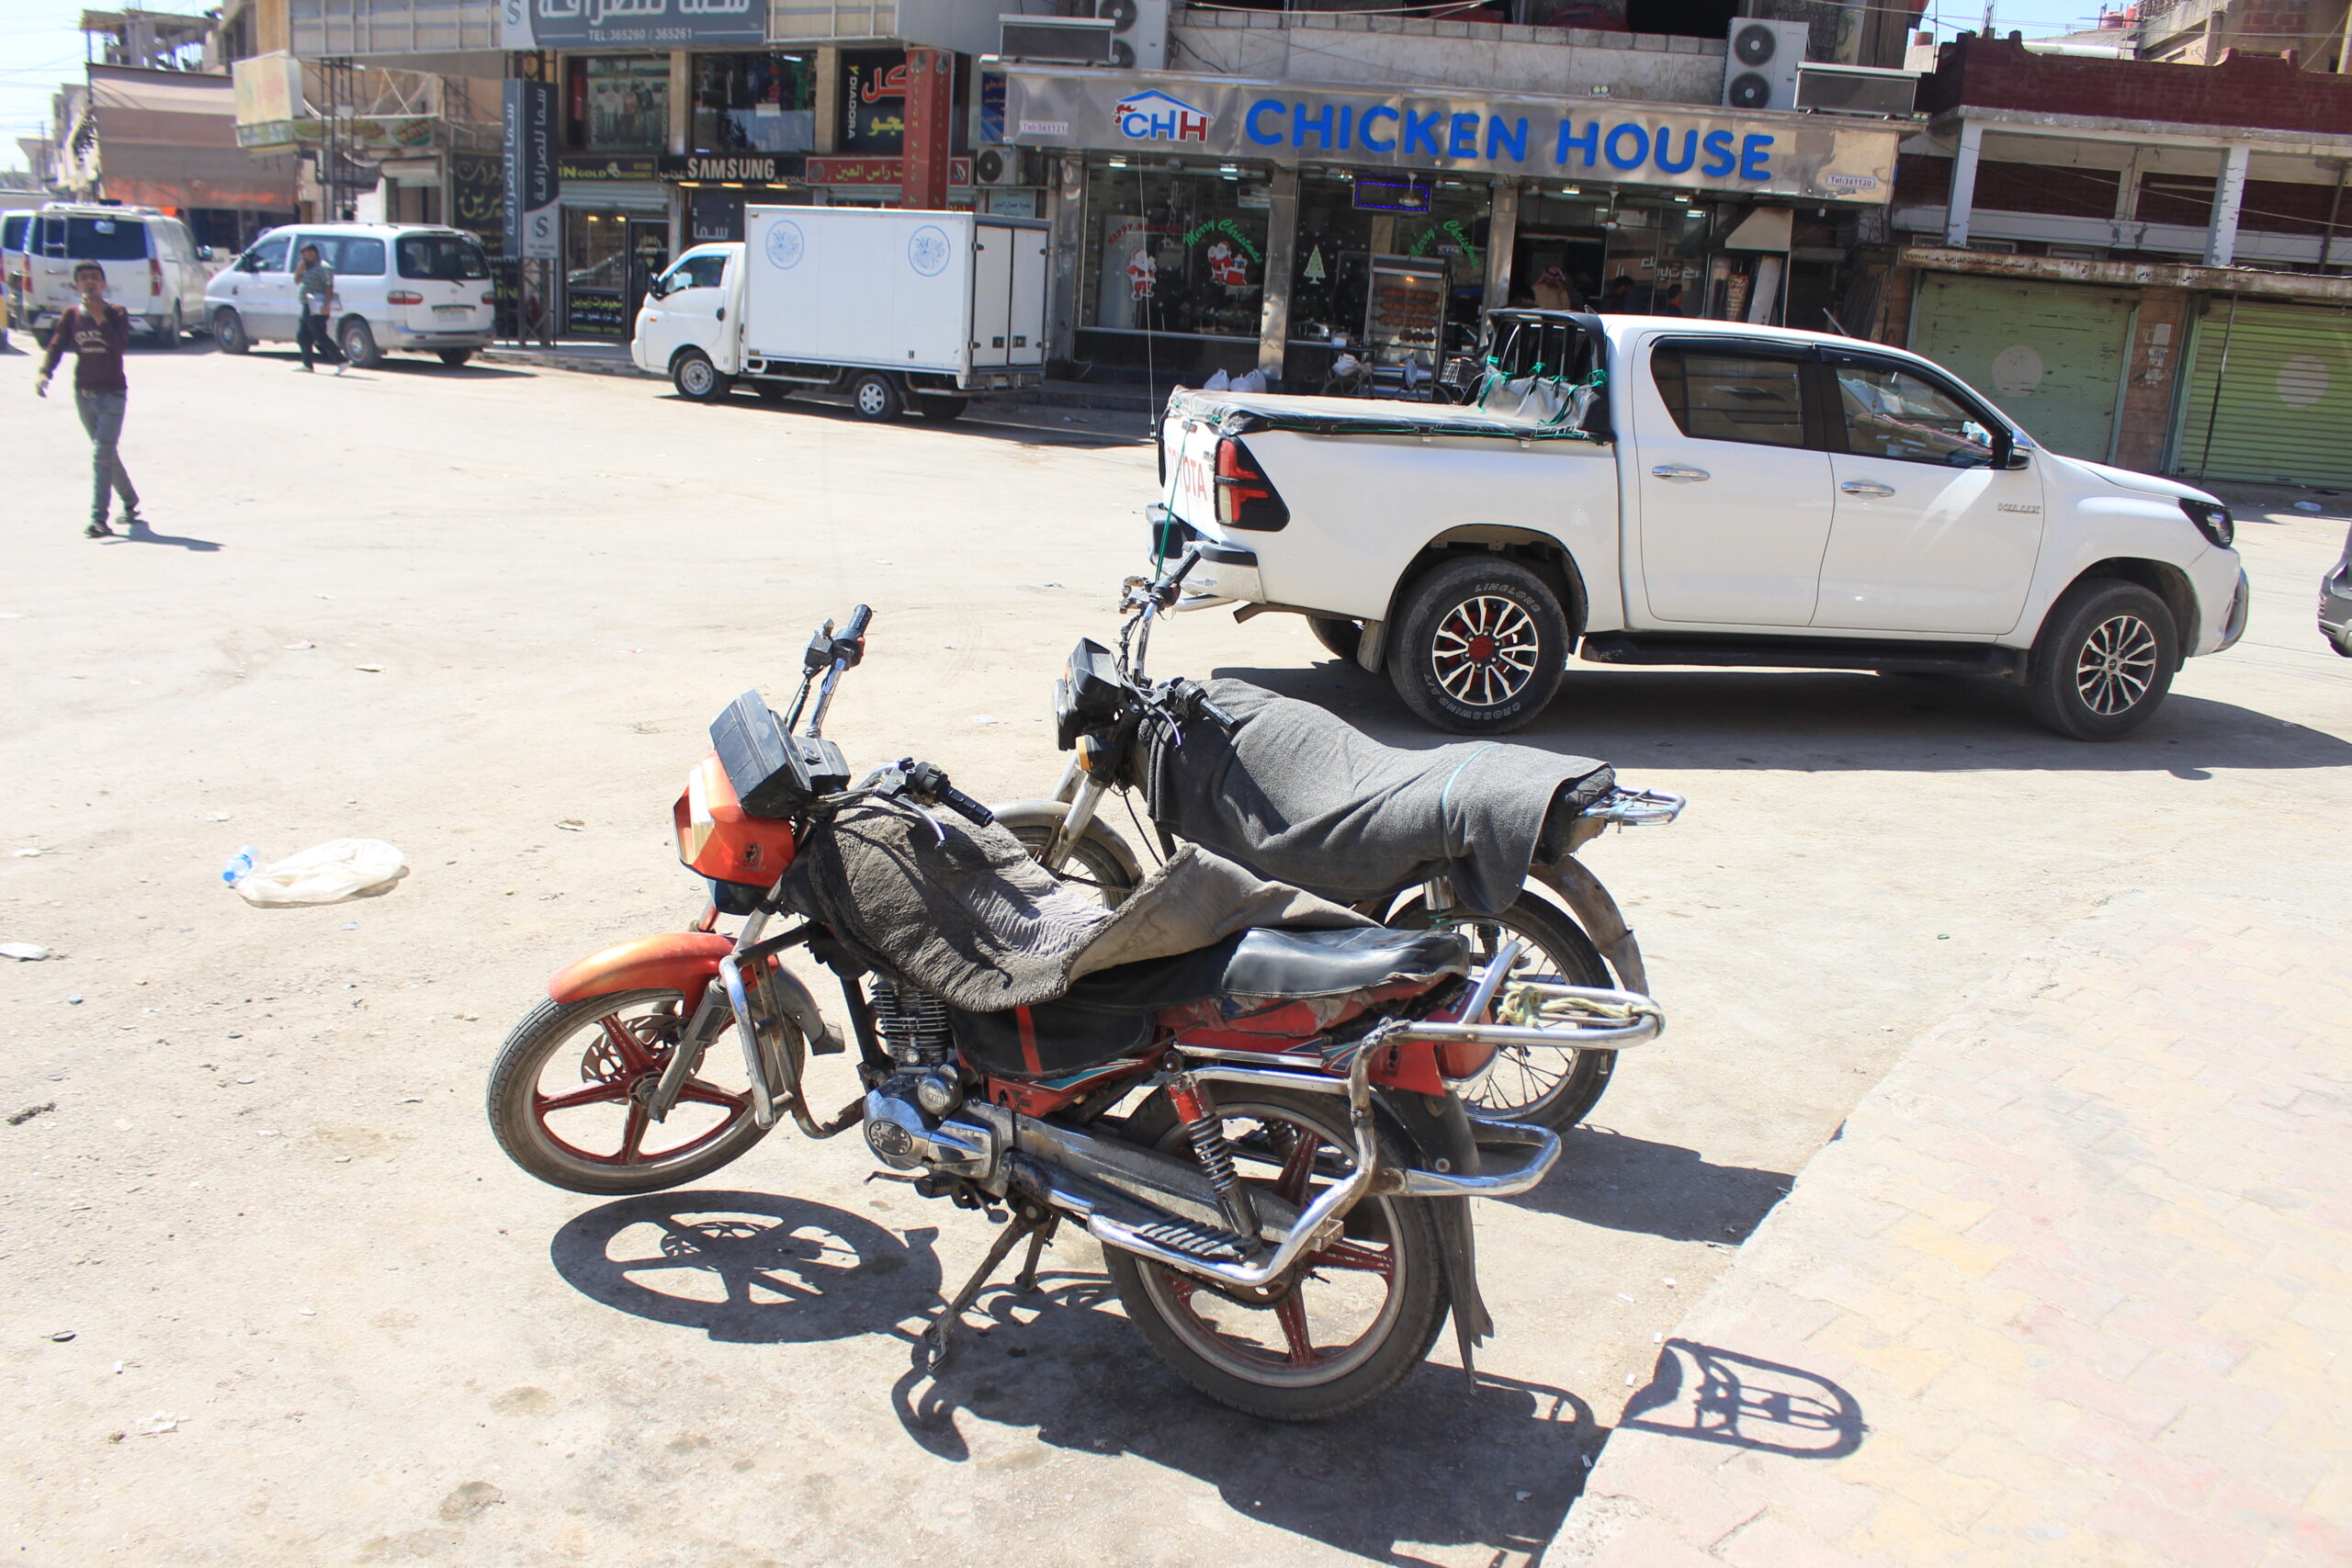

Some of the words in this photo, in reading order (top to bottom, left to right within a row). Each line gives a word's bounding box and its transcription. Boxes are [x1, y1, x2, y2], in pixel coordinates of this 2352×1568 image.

[655, 28, 692, 39] 365261
[534, 88, 546, 125] سما
[848, 76, 858, 139] DIADORA
[1120, 109, 1208, 142] CHH
[1245, 98, 1529, 163] CHICKEN
[1555, 119, 1775, 182] HOUSE
[534, 130, 549, 201] للصرافة
[577, 169, 606, 178] GOLD
[687, 157, 775, 179] SAMSUNG
[1830, 175, 1872, 186] Tel:361120
[1183, 220, 1216, 247] Merry
[1217, 219, 1263, 264] Christmas
[1167, 446, 1208, 502] TOYOTA
[1998, 502, 2041, 514] HILUX
[1475, 582, 1542, 613] LINGLONG
[1439, 697, 1521, 720] CROSSWIND
